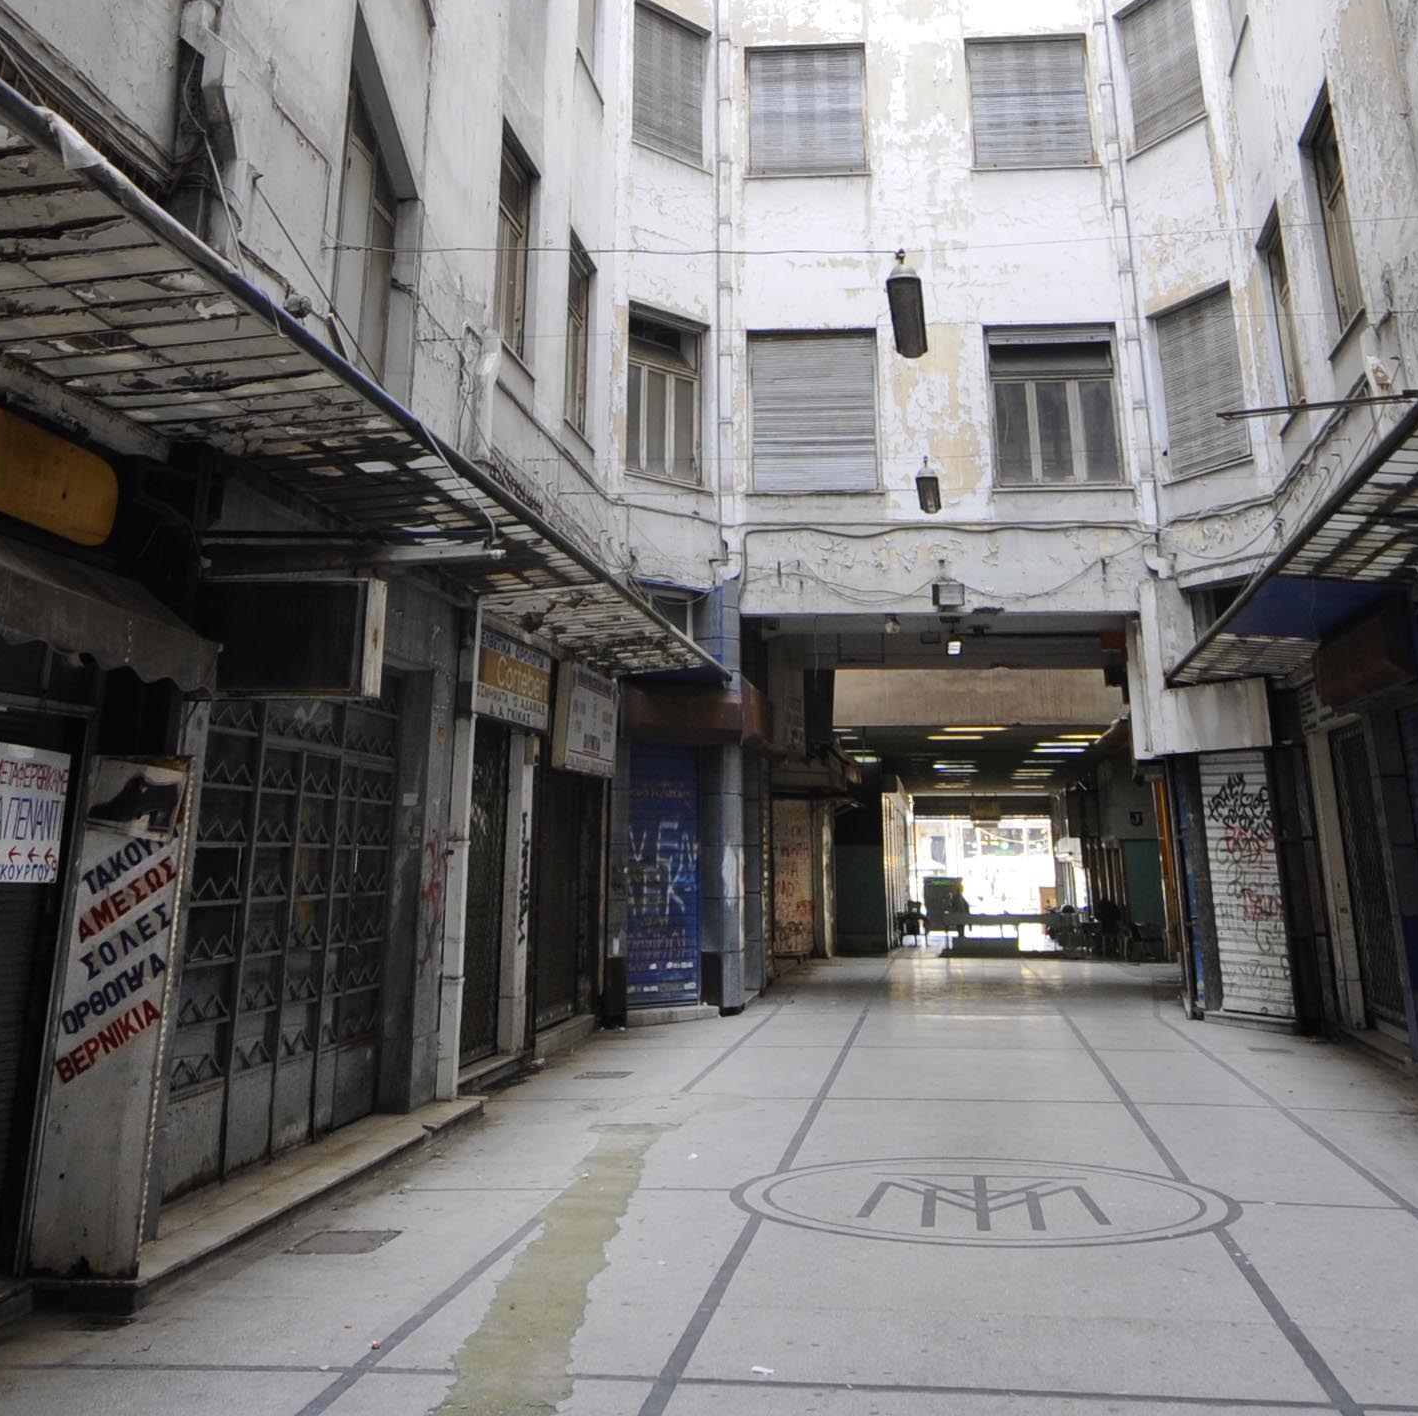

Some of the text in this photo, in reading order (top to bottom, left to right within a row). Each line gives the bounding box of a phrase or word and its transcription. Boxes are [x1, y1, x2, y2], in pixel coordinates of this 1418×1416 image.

[50, 859, 58, 883] 9
[78, 856, 177, 944] ΑΜΕΣΩΣ
[79, 902, 173, 981] ΣΟΛΕΣ
[55, 999, 162, 1084] ΒΕΡΝΙΚΙΑ
